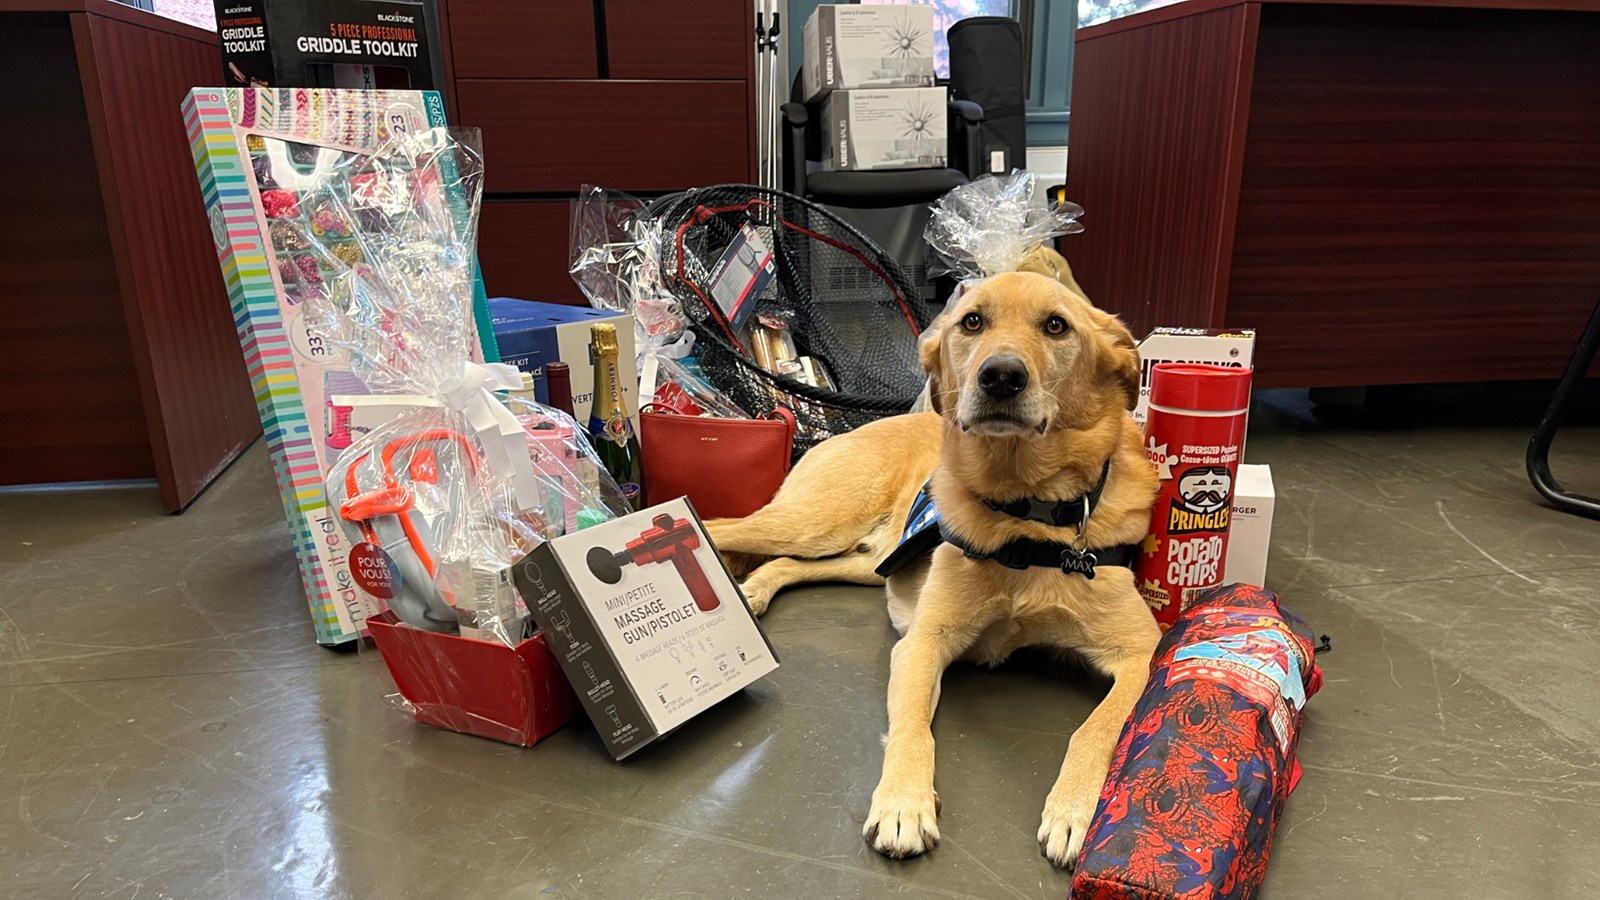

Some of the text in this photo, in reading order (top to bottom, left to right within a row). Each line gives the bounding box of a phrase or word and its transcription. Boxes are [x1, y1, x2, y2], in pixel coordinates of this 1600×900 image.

[377, 13, 415, 23] BLACKSTONE
[222, 26, 265, 40] GRIDDLE
[331, 23, 417, 41] 5 PIECE PROFESSIONAL
[224, 40, 265, 53] TOOLKIT
[297, 36, 418, 57] GRIDDLE TOOLKIT
[391, 115, 406, 134] 23
[609, 362, 618, 402] POMMERY
[1146, 449, 1166, 464] 000
[1182, 445, 1219, 454] SUPERSIZED
[1169, 505, 1229, 530] PRINGLES
[315, 516, 340, 552] real
[357, 557, 387, 568] POUR
[1065, 558, 1093, 573] MAX
[359, 569, 392, 580] VOUS!
[1167, 560, 1218, 586] CHIPS
[336, 568, 363, 623] make
[604, 582, 656, 612] MINI/PETITE
[614, 598, 666, 629] MASSAGE
[623, 602, 697, 645] GUN/PISTOLET
[639, 644, 663, 661] MASSAGE
